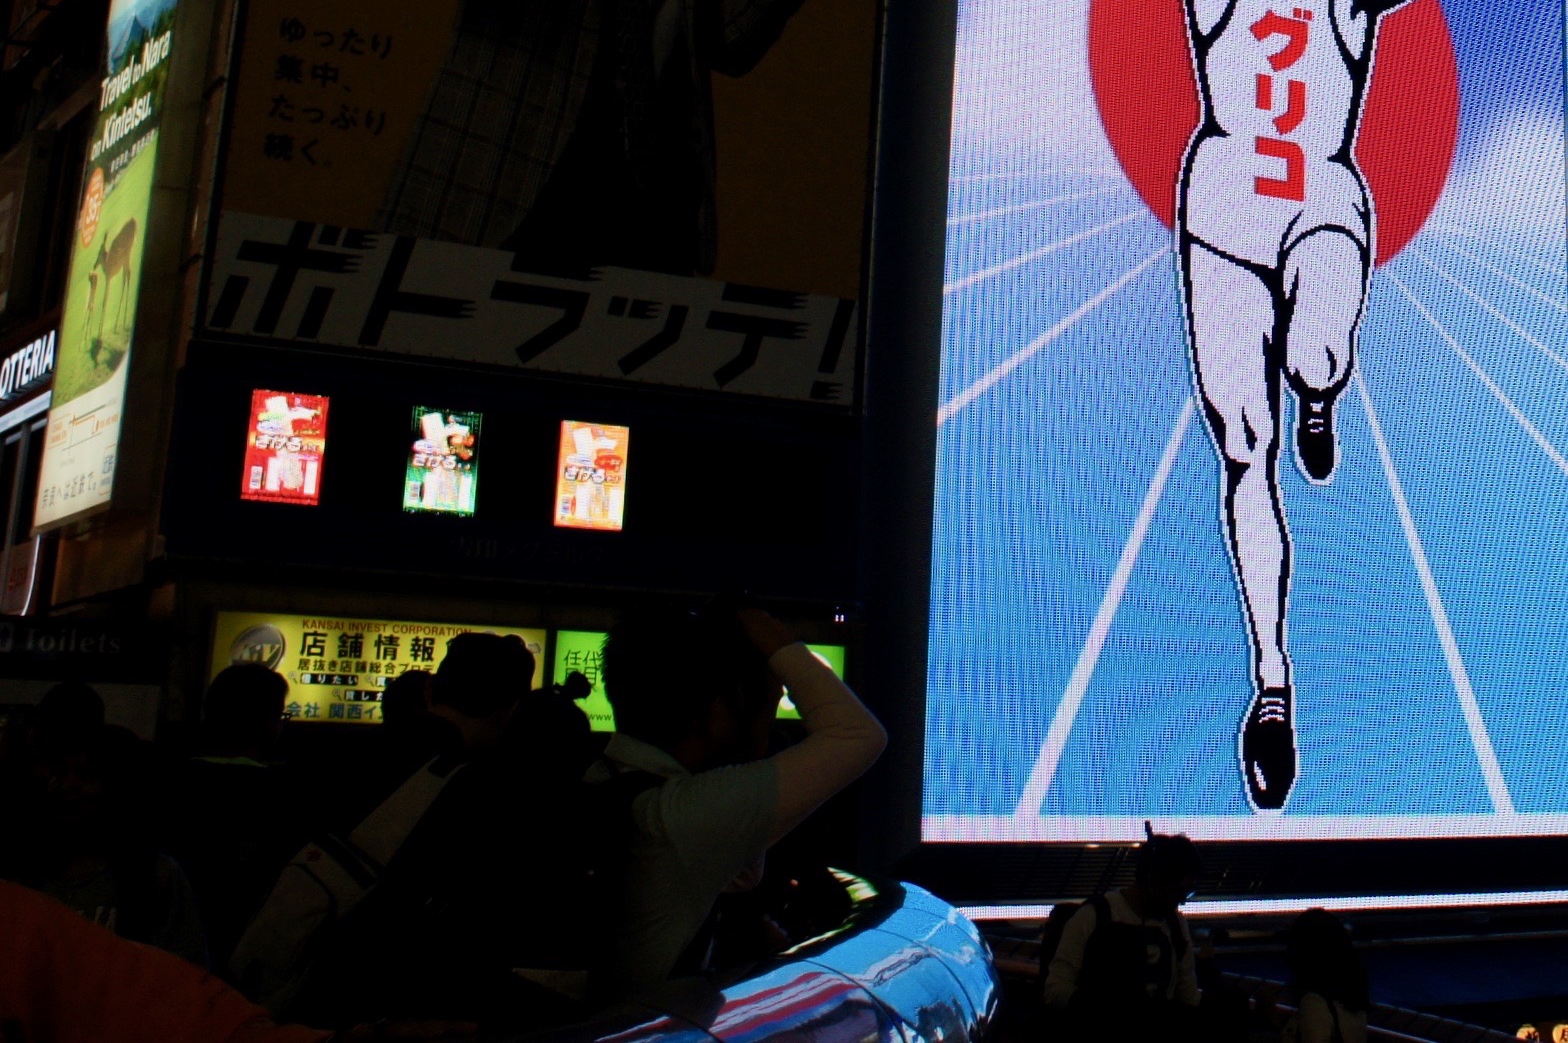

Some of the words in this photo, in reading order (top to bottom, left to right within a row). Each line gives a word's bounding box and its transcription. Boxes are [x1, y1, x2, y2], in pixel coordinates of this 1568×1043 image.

[280, 16, 395, 59] ゆったり
[99, 54, 136, 111] Travel
[141, 30, 171, 78] Nara
[274, 55, 352, 93] 集中、
[268, 93, 389, 137] たっぷり
[1249, 7, 1314, 203] グリコ
[24, 627, 121, 654] Toilets
[302, 619, 345, 630] KANSAI
[347, 621, 388, 633] INVEST
[391, 624, 472, 637] CORPORATION
